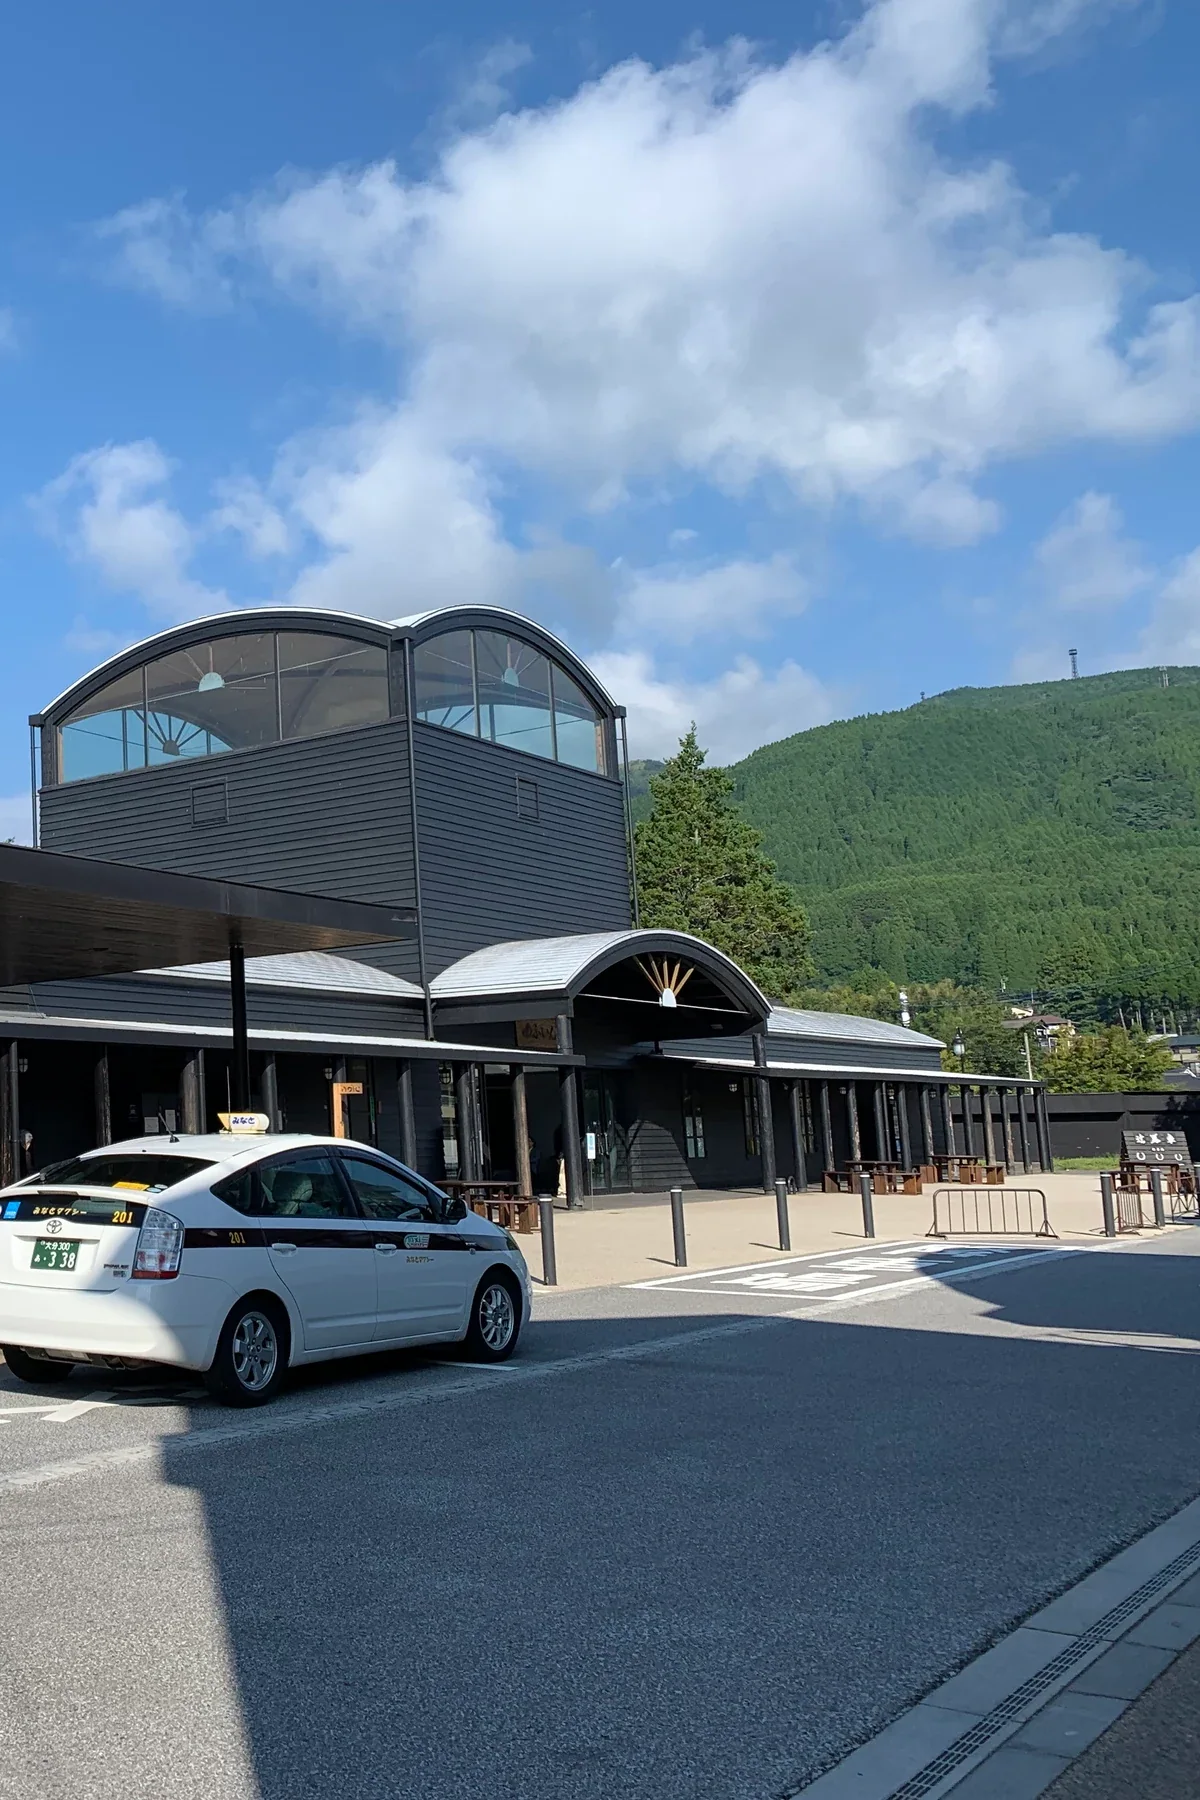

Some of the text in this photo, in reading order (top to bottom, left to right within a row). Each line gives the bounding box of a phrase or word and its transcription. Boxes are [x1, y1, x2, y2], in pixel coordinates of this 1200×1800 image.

[232, 1116, 255, 1125] みなと
[112, 1211, 133, 1224] 201
[228, 1231, 245, 1244] 201
